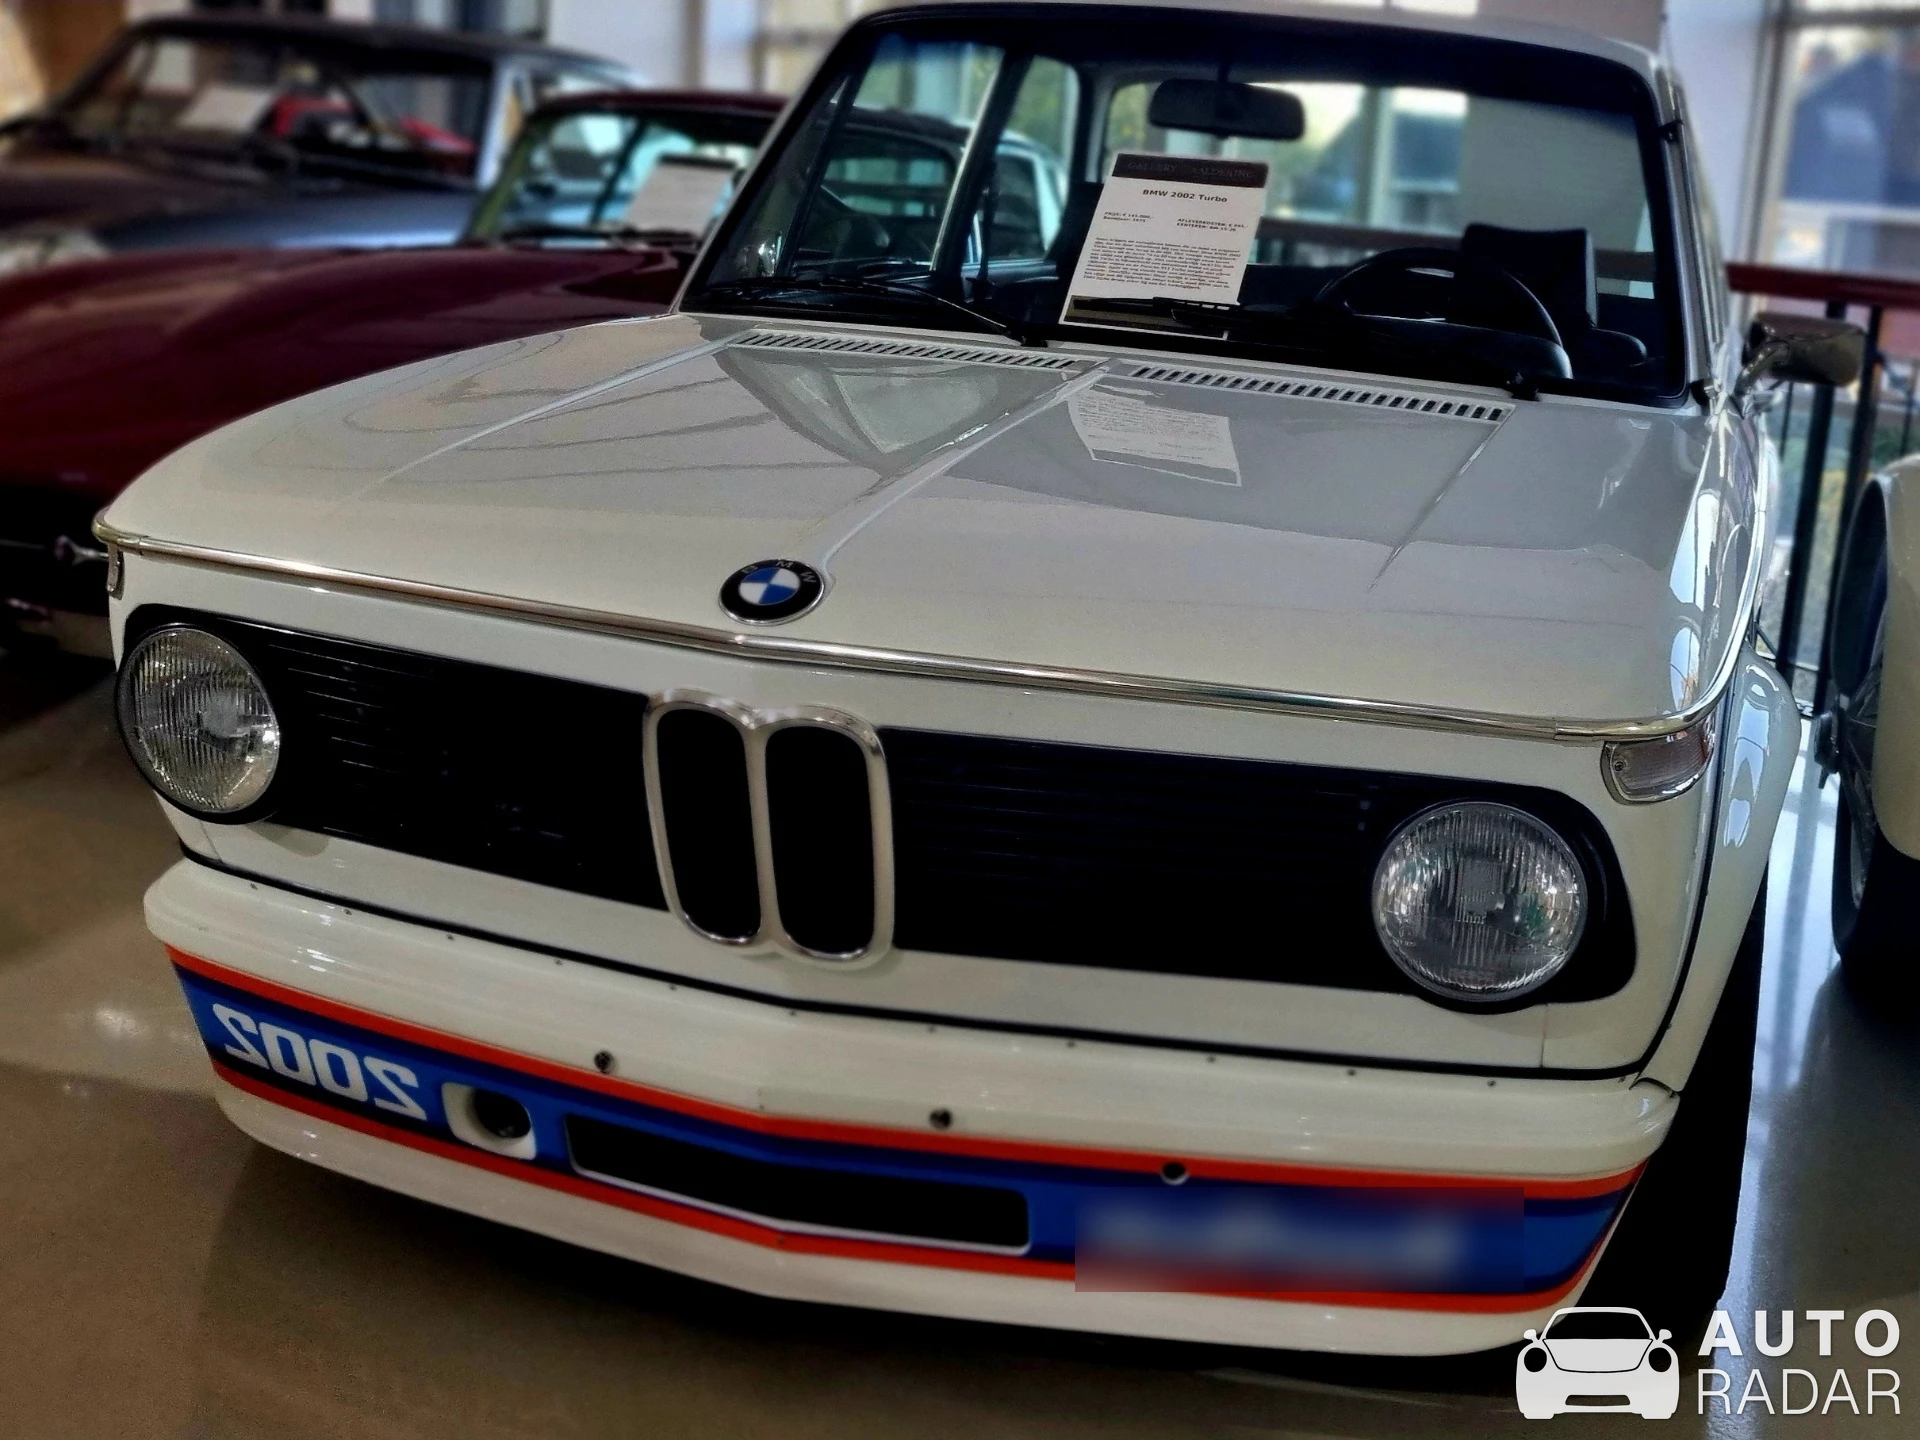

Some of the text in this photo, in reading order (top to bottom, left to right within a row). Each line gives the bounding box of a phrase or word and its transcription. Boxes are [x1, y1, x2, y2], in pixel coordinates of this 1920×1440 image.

[1142, 189, 1228, 203] BMW 2002 Turbo
